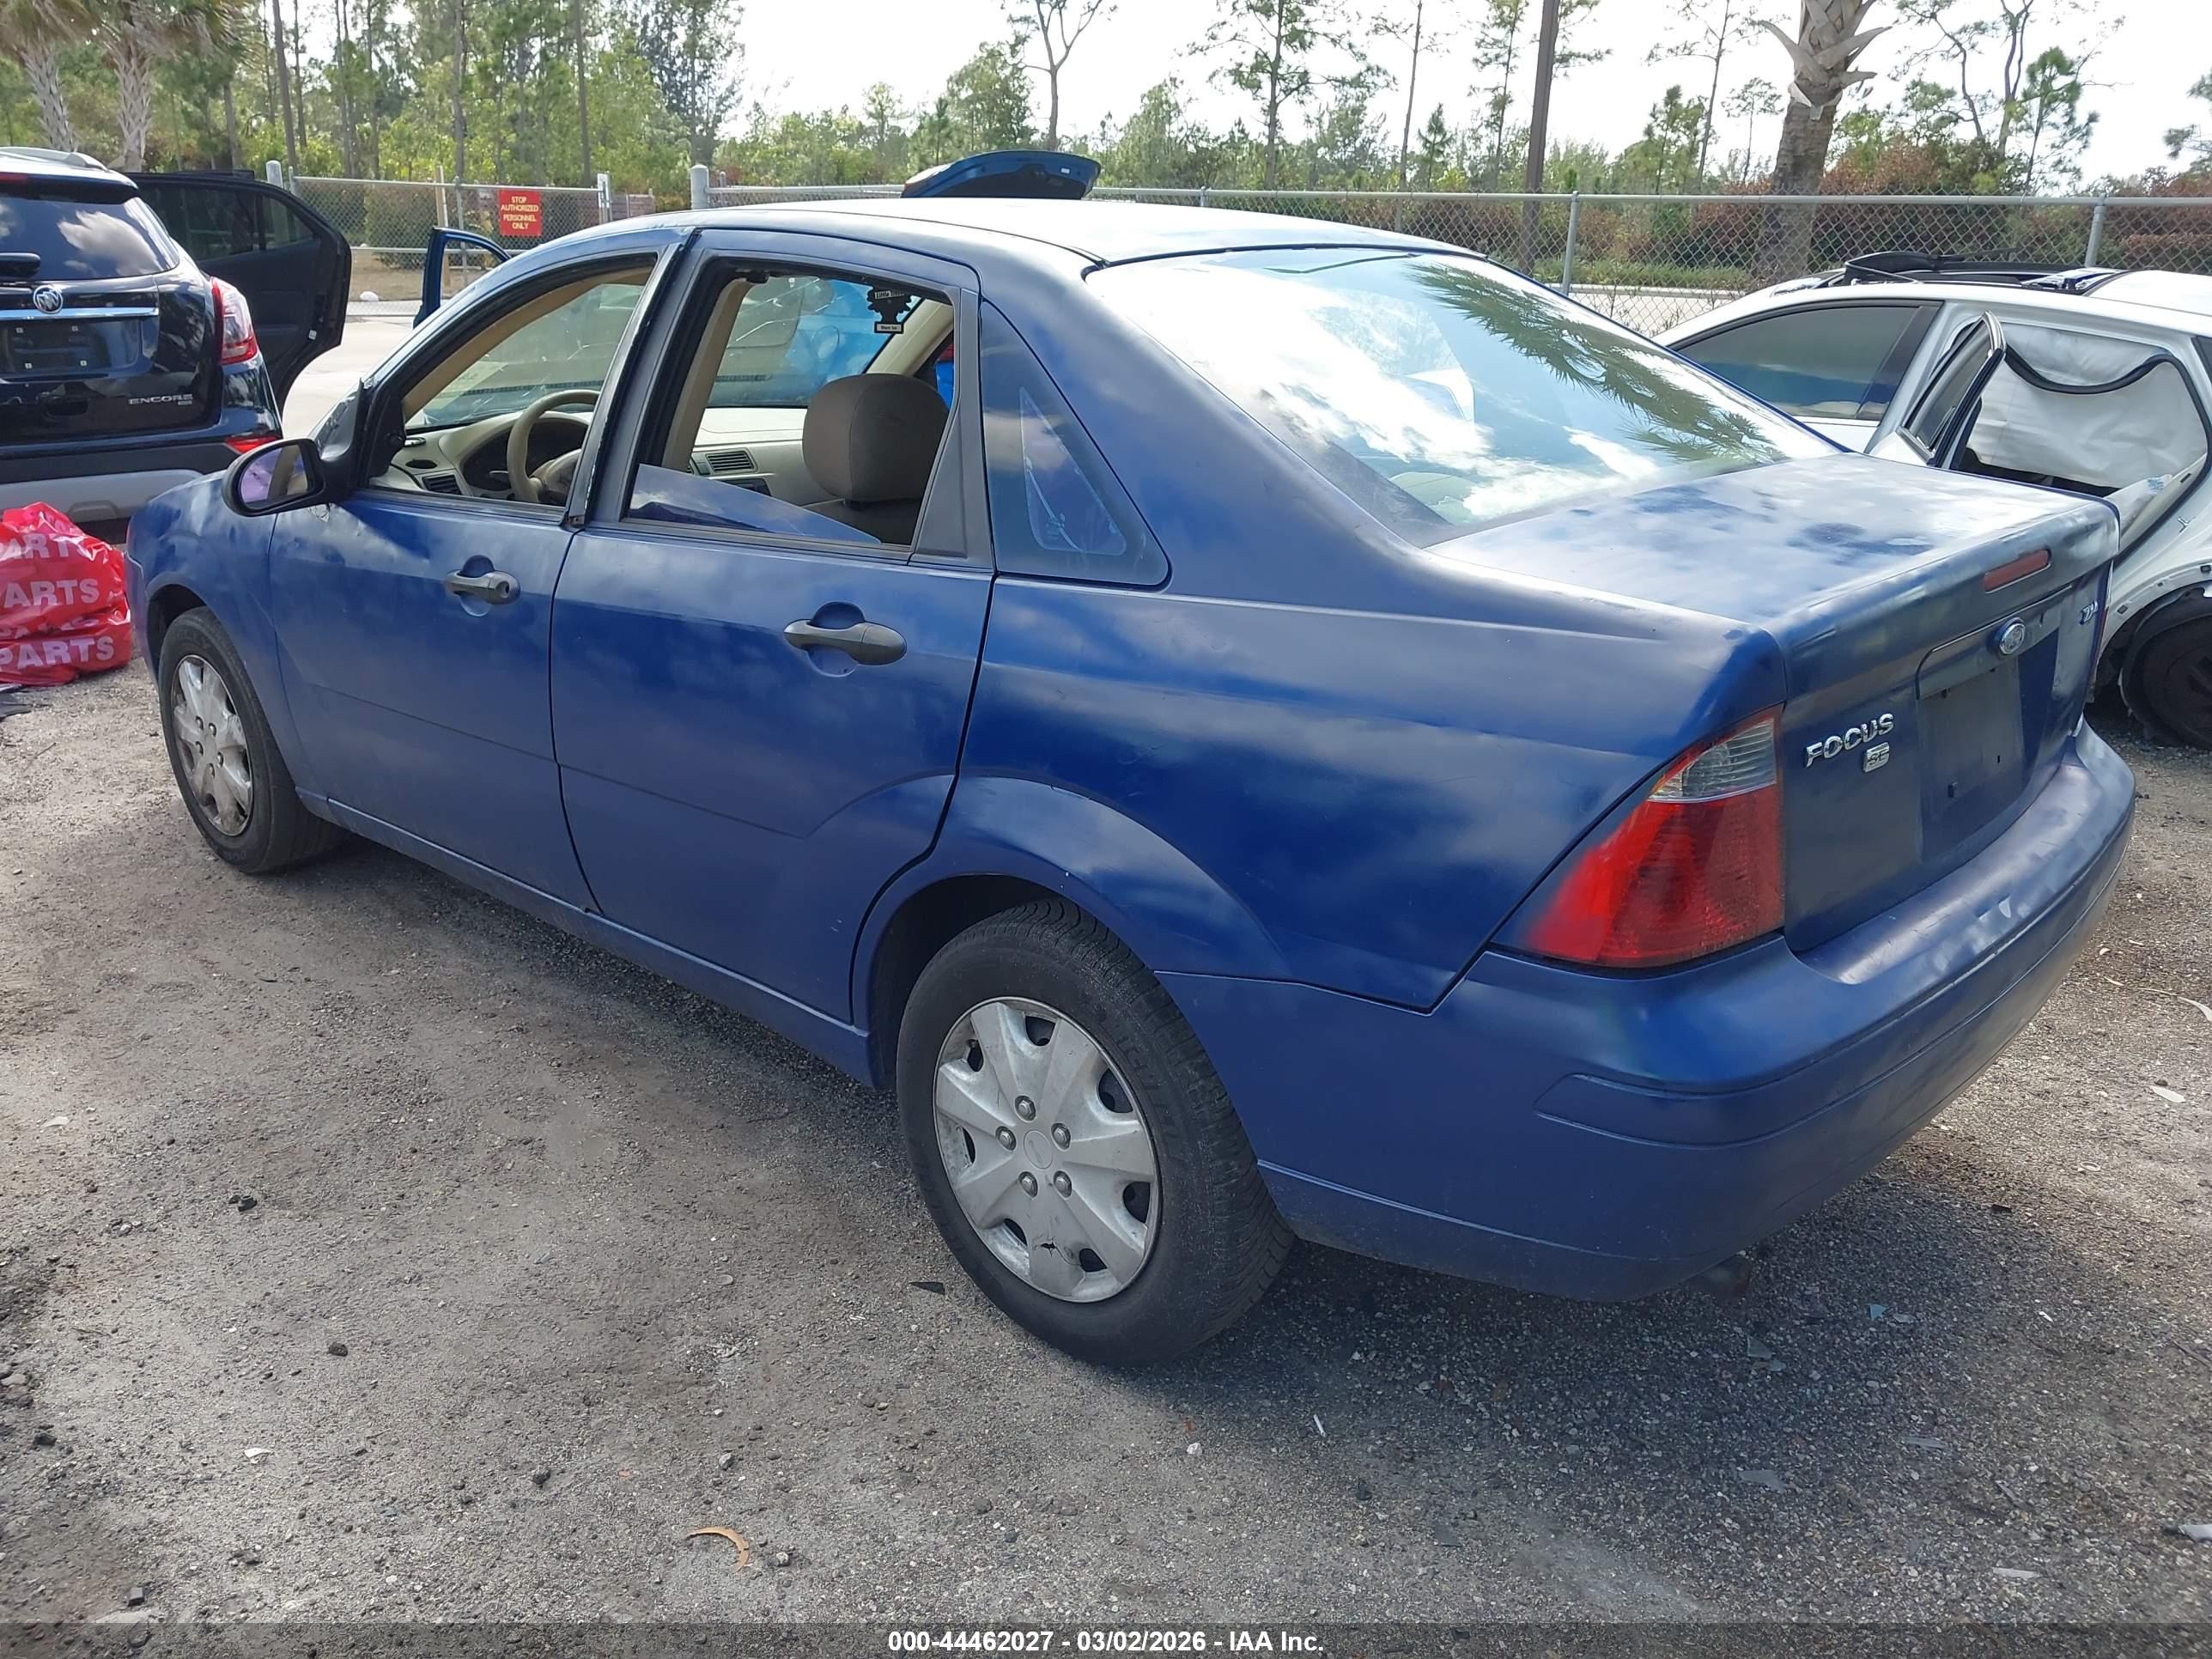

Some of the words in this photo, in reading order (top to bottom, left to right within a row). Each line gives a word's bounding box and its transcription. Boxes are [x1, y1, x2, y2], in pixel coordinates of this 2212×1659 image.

[501, 204, 538, 212] AUTHORIZED
[128, 393, 193, 405] ENCORE
[0, 533, 92, 560] ART
[0, 578, 100, 608] ARTS
[1806, 713, 1894, 768] FOCUS
